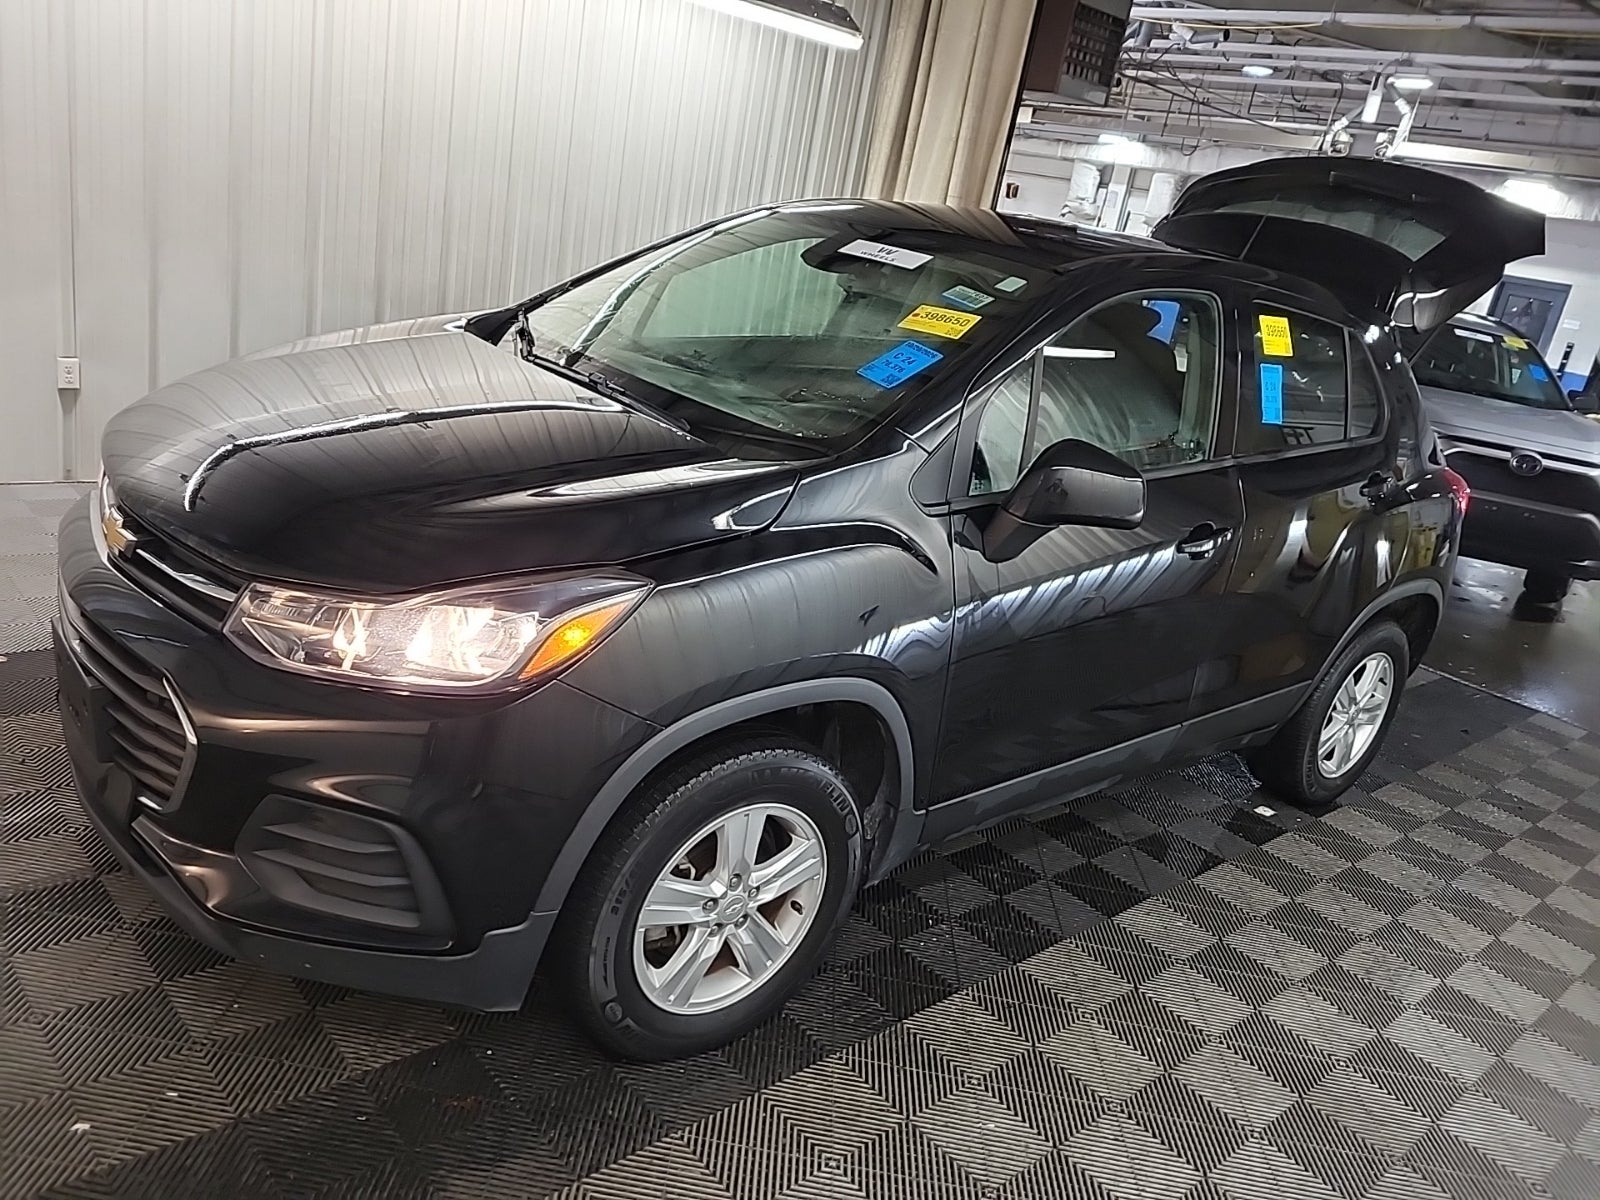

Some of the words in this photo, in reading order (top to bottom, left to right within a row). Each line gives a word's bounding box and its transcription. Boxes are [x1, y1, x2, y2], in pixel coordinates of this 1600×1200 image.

[860, 251, 897, 262] WHEELS
[920, 311, 970, 327] 398650
[893, 352, 904, 360] C
[901, 356, 917, 366] 24
